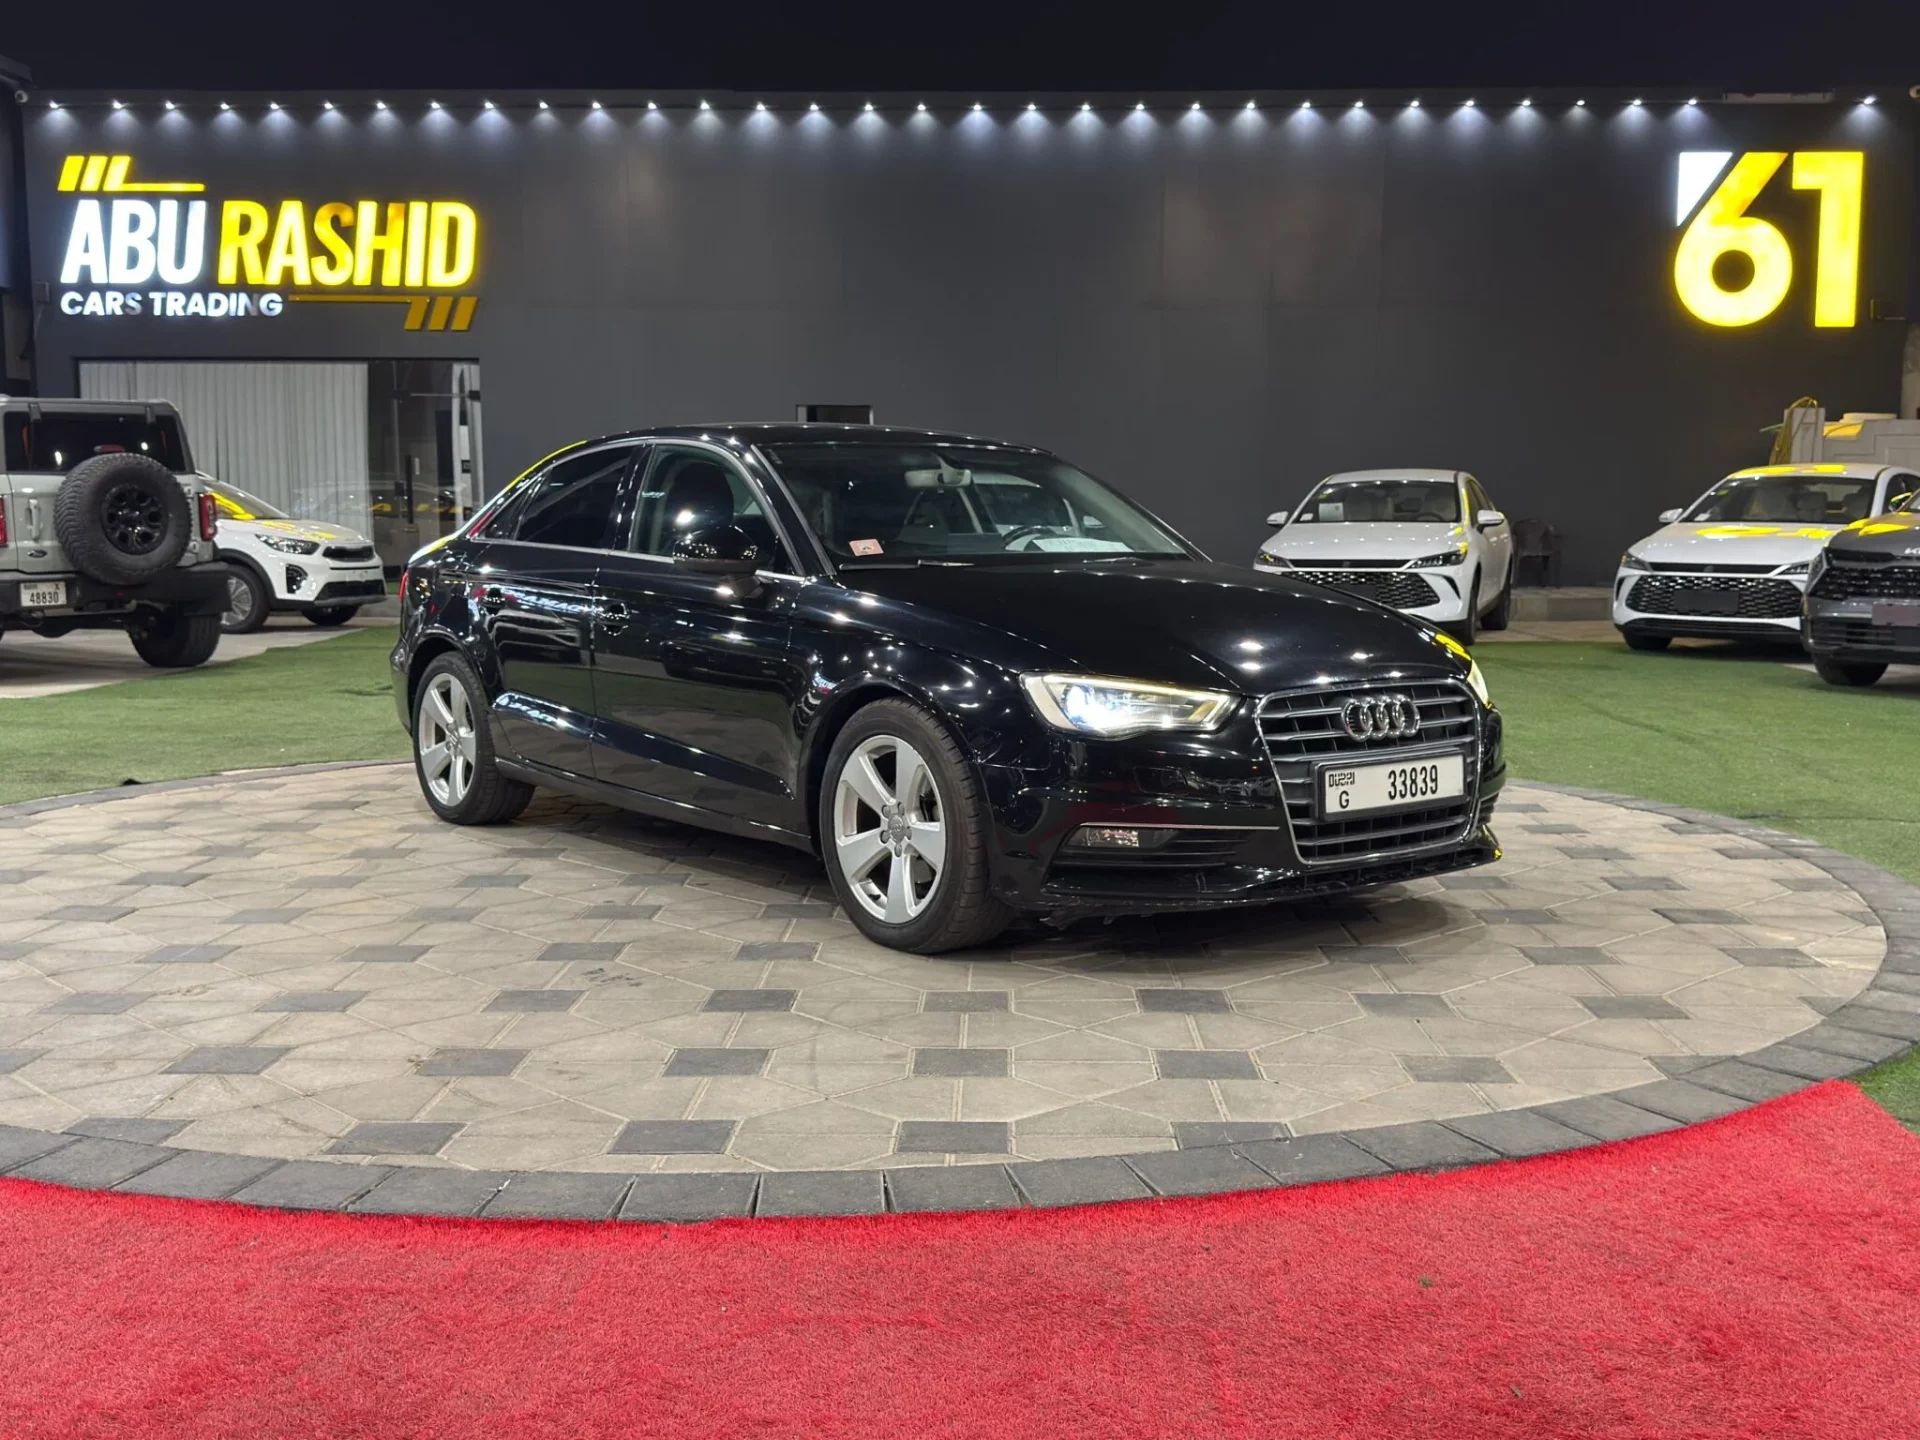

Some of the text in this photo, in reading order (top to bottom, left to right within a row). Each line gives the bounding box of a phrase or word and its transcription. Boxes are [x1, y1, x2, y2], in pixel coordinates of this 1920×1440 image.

[60, 199, 477, 288] ABU RASHID
[1674, 151, 1864, 328] 61
[60, 291, 284, 317] CARS TRADING
[29, 591, 60, 605] 48830
[1388, 764, 1438, 800] 33839
[1339, 790, 1350, 809] G
